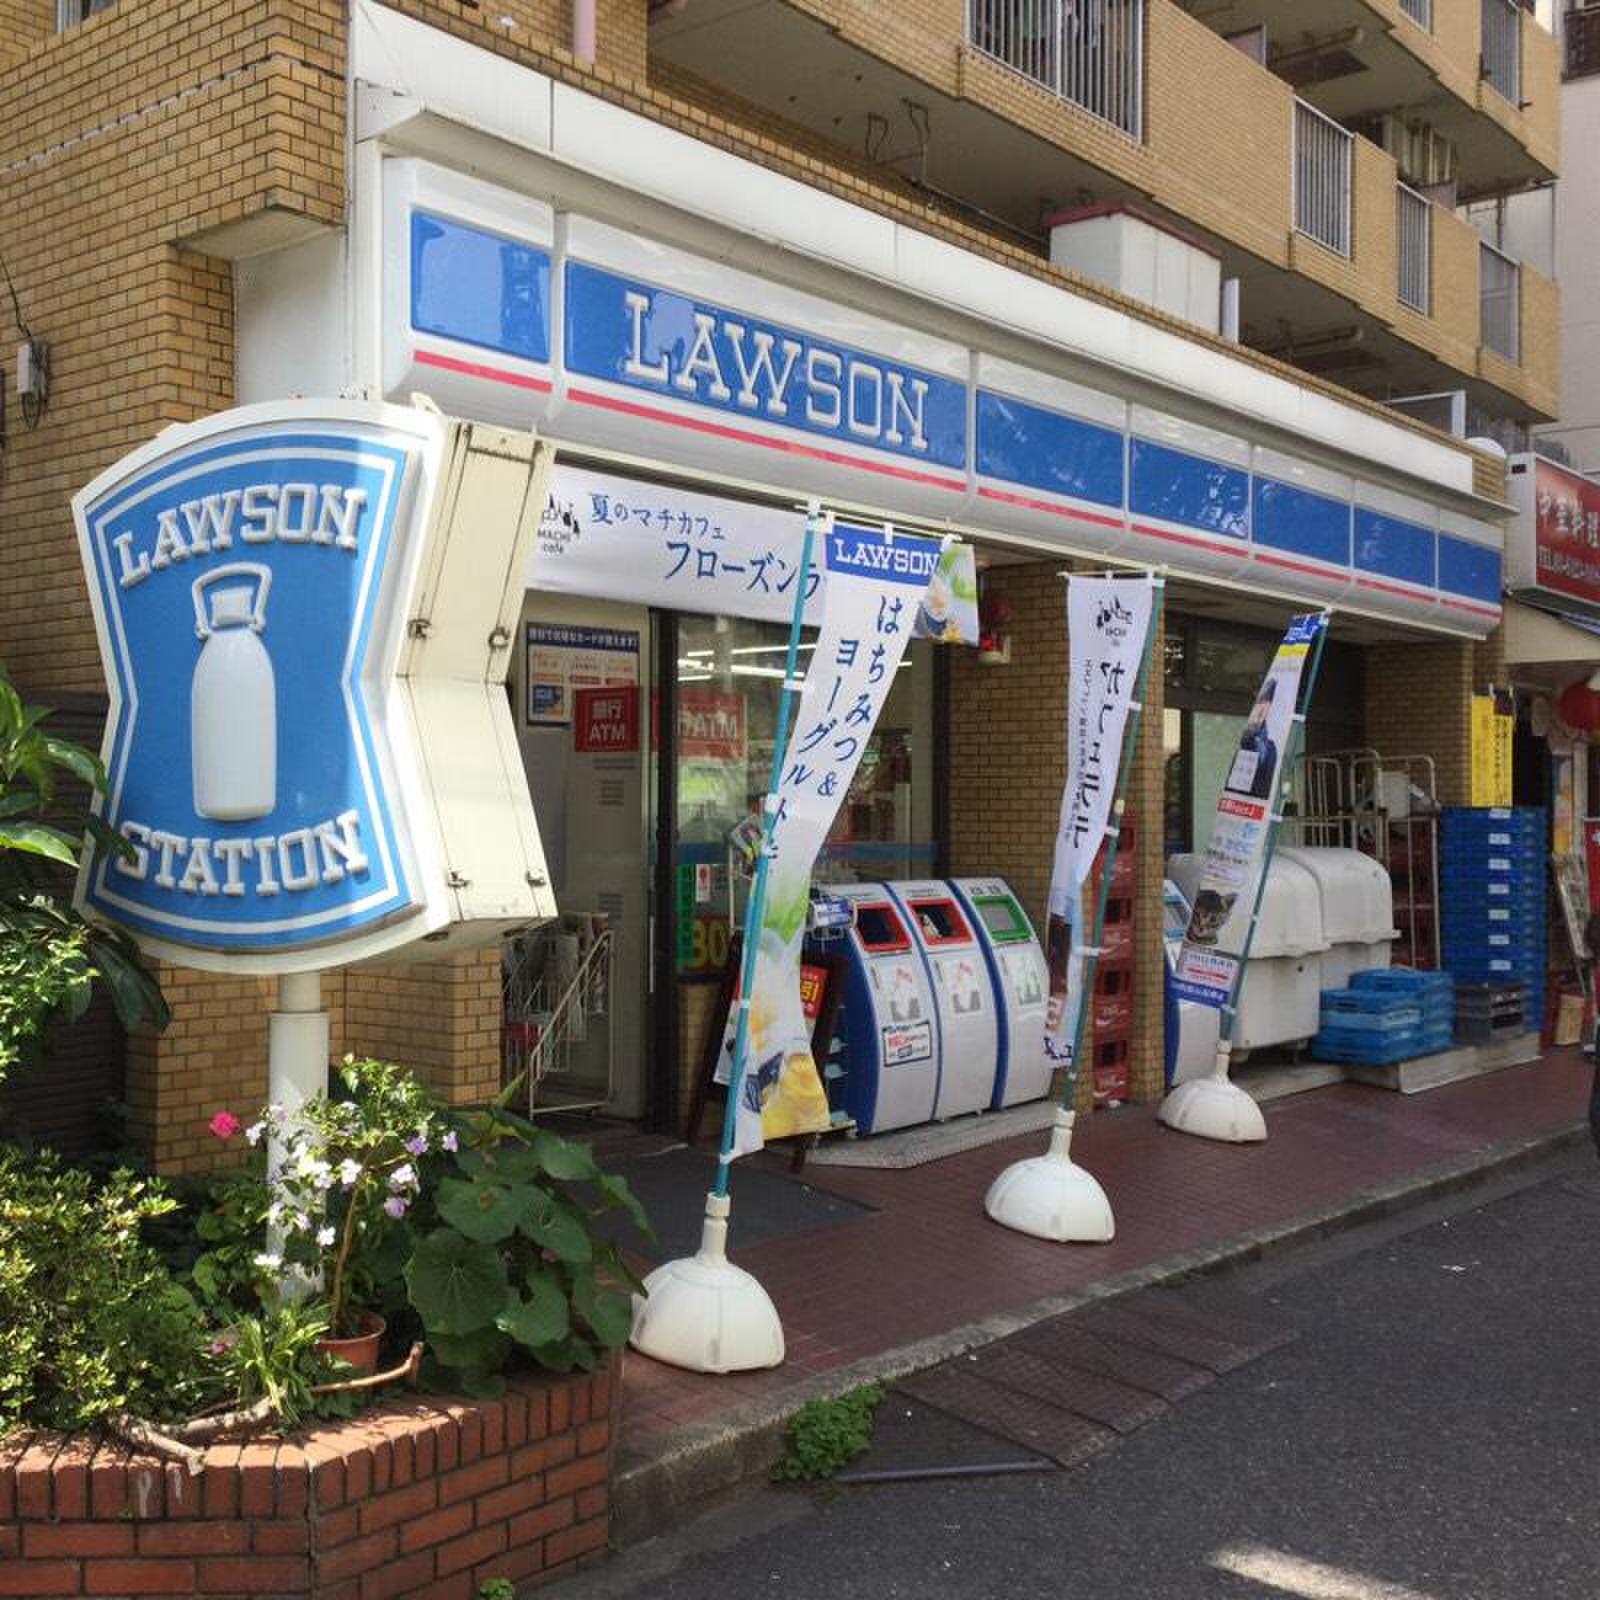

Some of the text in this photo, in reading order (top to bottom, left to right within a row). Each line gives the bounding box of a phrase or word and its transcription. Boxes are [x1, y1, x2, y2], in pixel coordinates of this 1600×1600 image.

[625, 292, 929, 450] LAWSON
[113, 483, 368, 589] LAWSON
[589, 492, 726, 541] 夏のマチカフェ
[834, 538, 940, 576] LAWSON
[589, 722, 625, 742] ATM
[116, 808, 369, 897] STATION
